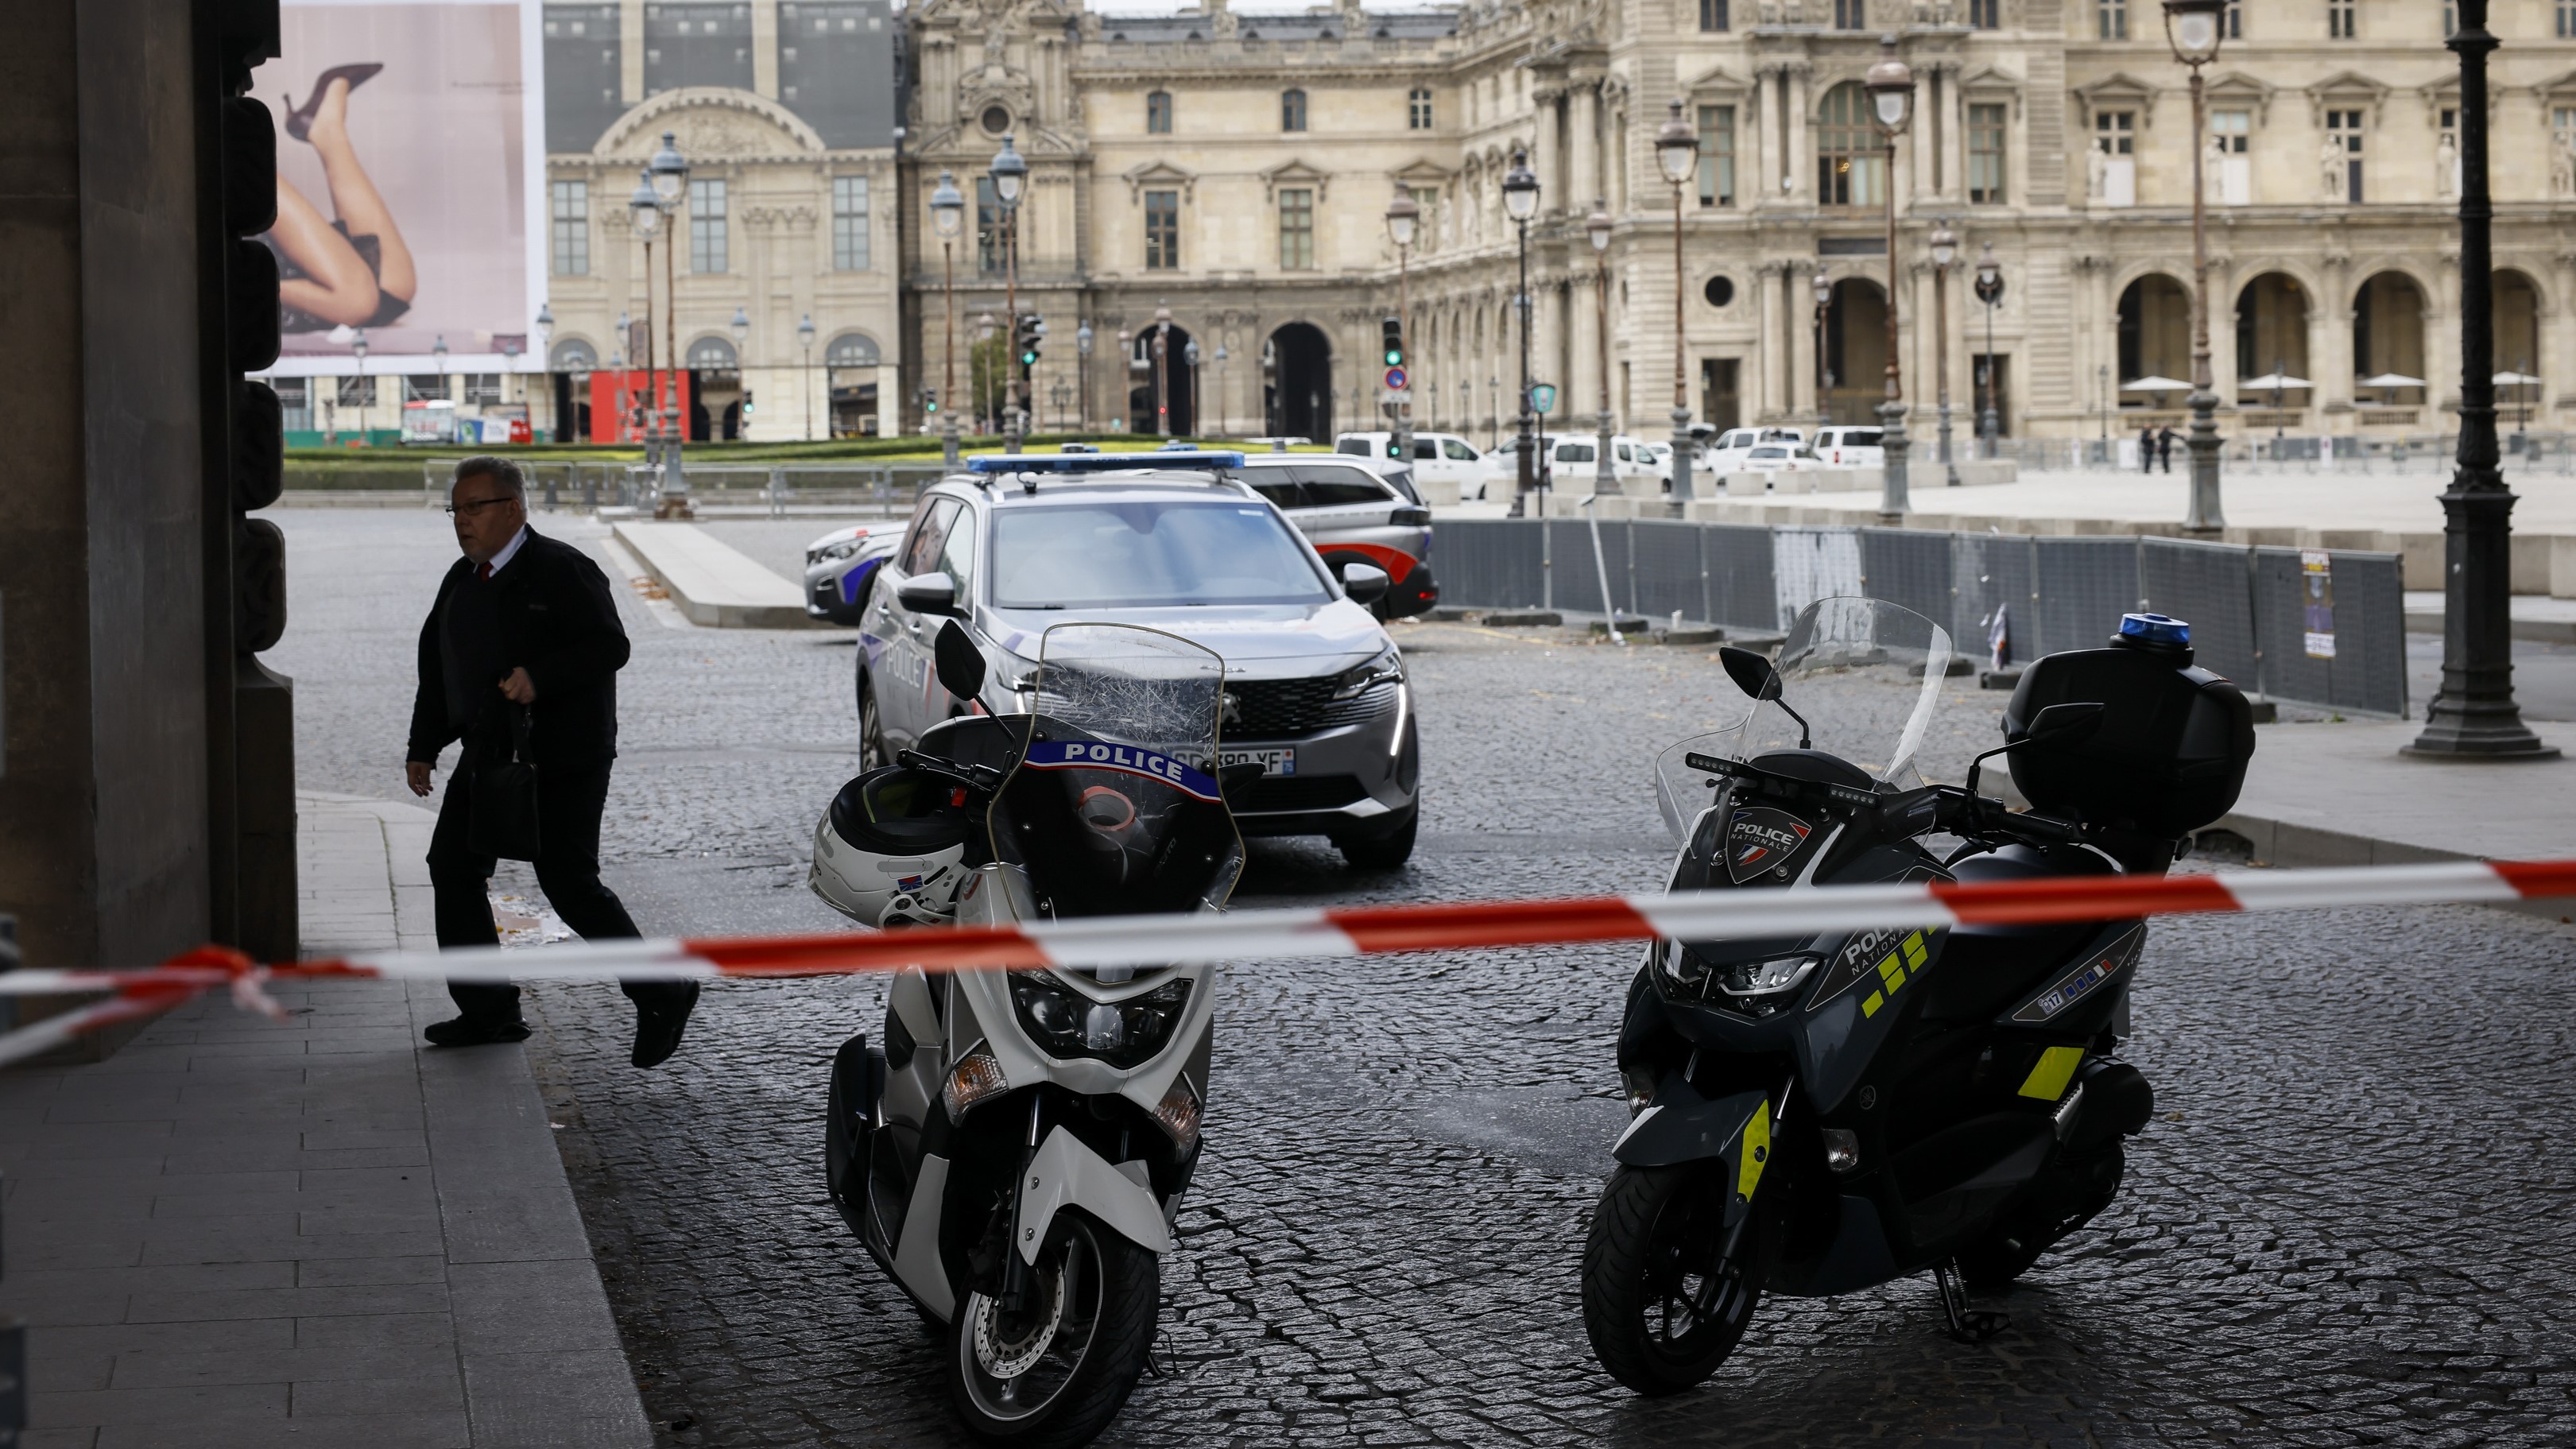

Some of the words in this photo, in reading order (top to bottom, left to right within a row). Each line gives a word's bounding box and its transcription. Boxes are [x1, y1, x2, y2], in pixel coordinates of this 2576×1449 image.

[886, 642, 920, 688] POLICE
[1065, 743, 1183, 781] POLICE
[1730, 833, 1790, 853] NATIONALE
[1733, 823, 1795, 846] POLICE
[1845, 925, 1894, 966] POL
[1851, 927, 1910, 976] NATIONA
[2048, 994, 2061, 1006] 17
